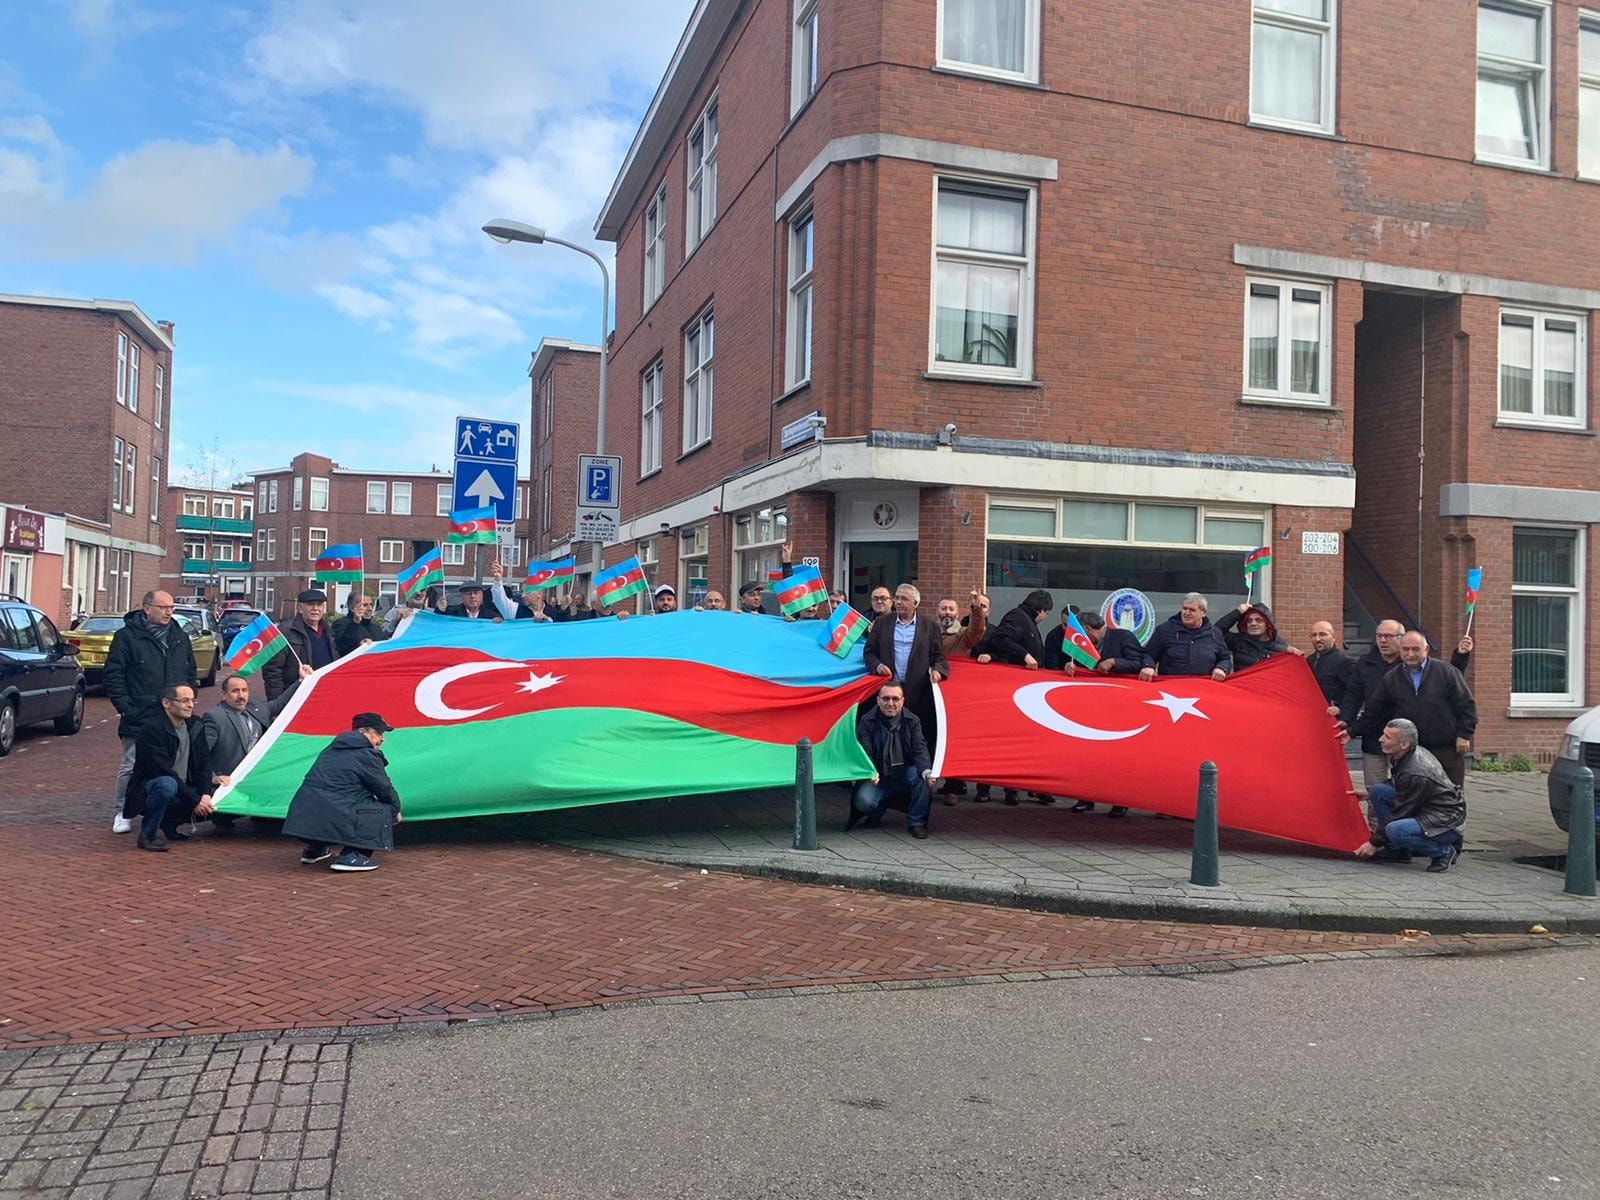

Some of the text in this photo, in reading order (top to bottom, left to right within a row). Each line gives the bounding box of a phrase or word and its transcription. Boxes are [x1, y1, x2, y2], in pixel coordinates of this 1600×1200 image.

[593, 469, 606, 487] P
[1304, 533, 1337, 543] 202-204
[1304, 543, 1337, 553] 200-206
